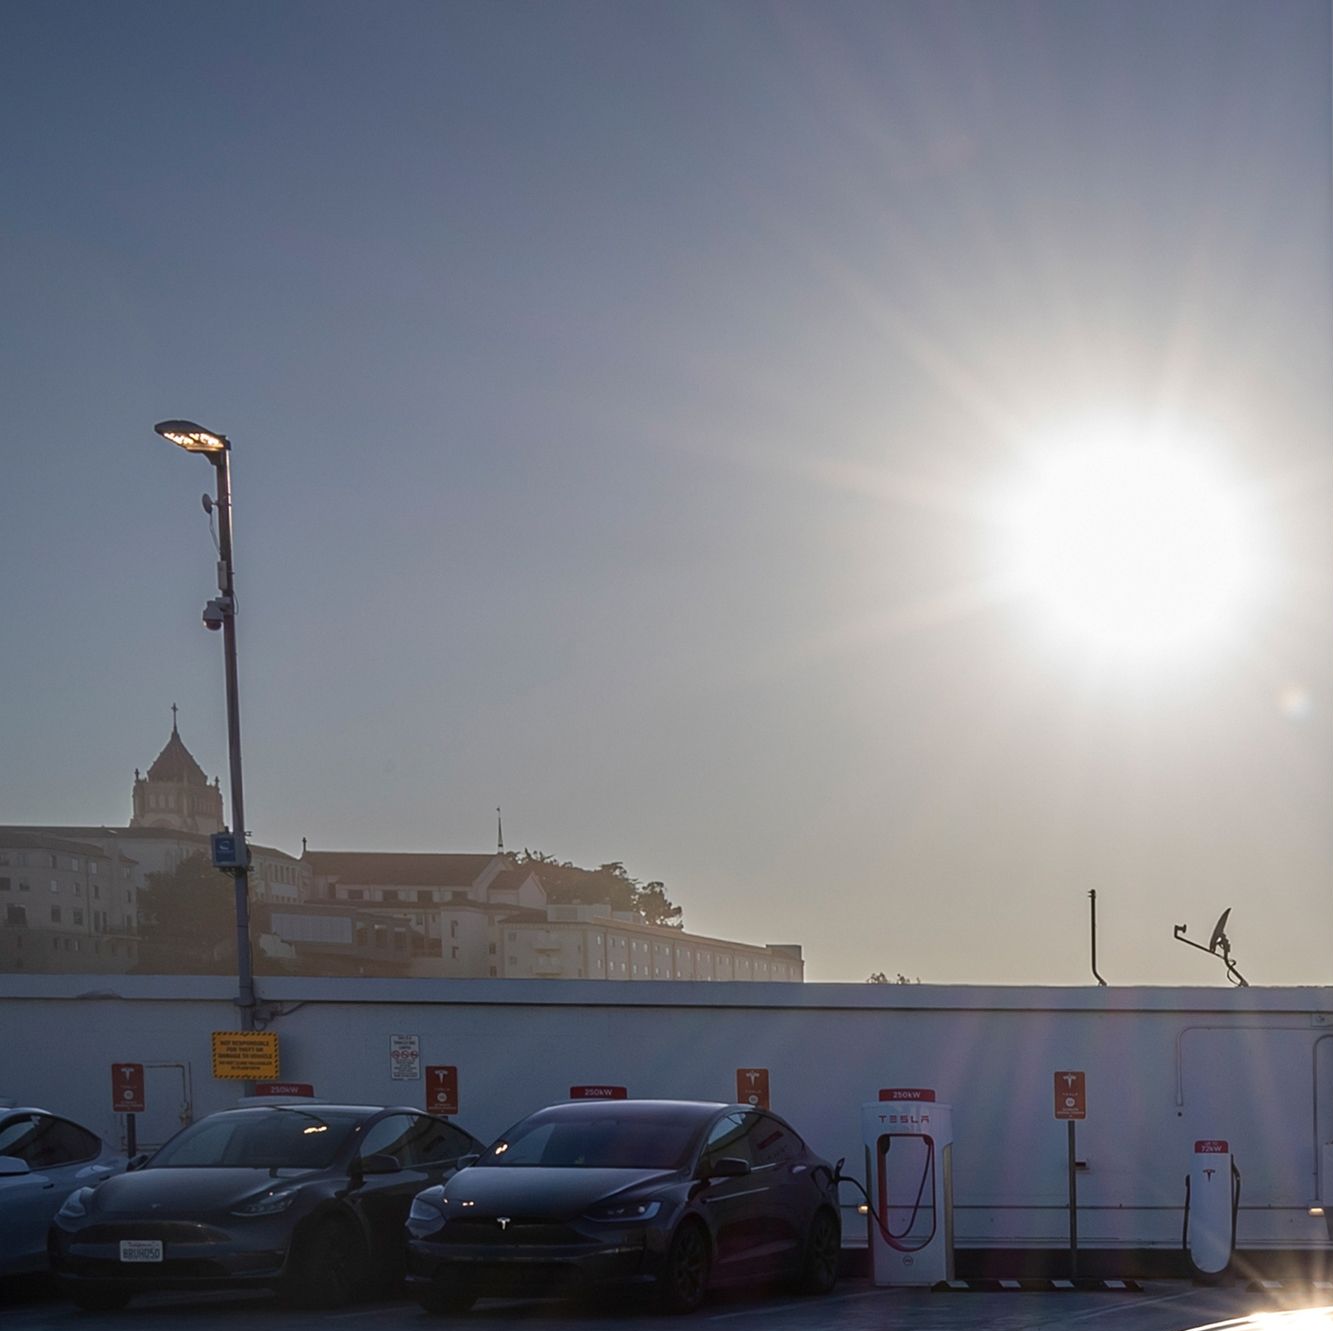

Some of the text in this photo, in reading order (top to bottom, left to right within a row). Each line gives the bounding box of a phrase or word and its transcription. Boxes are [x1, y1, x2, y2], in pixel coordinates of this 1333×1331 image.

[584, 1088, 613, 1097] 250kW
[893, 1091, 921, 1099] 250kW
[878, 1114, 930, 1124] TESLA
